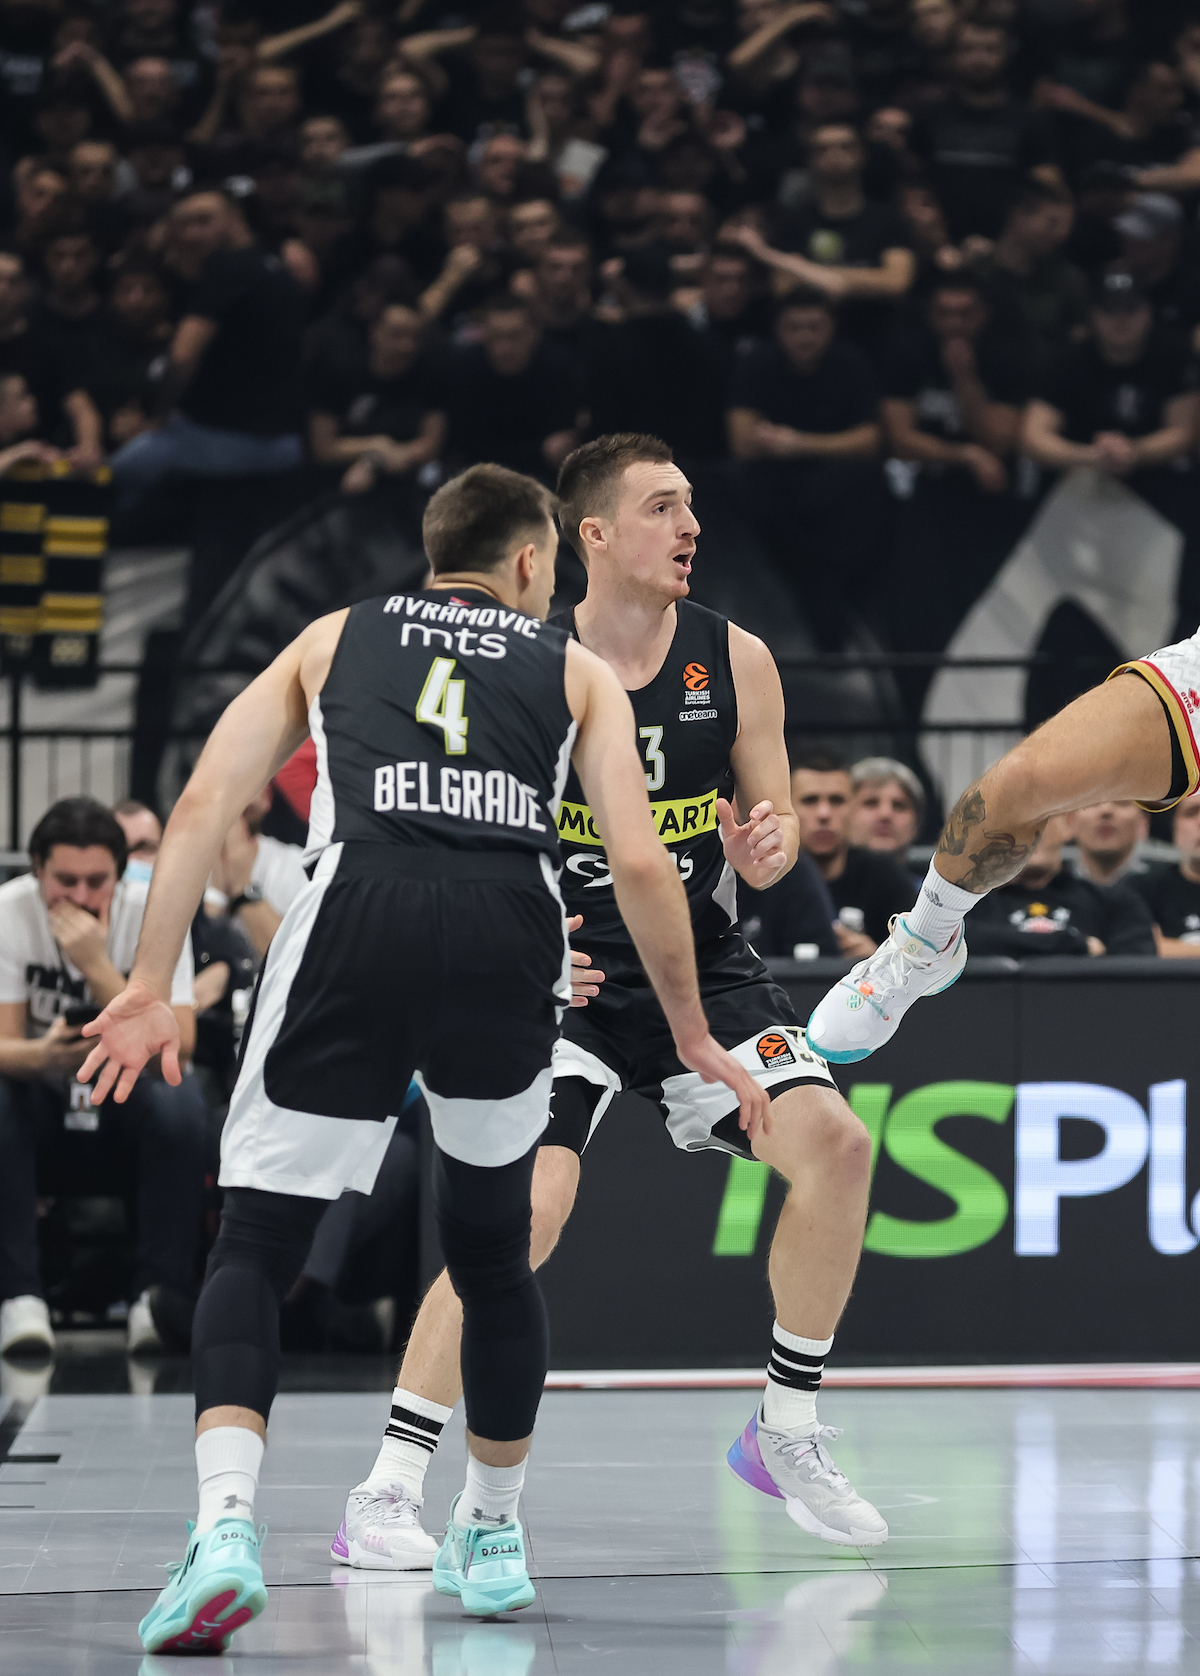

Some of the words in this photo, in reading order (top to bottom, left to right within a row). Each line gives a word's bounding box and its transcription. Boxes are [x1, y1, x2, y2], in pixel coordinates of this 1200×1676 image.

[383, 595, 541, 639] AVRAMOVIĆ
[400, 623, 507, 659] mts
[415, 657, 470, 755] 4
[374, 761, 547, 833] BELGRADE
